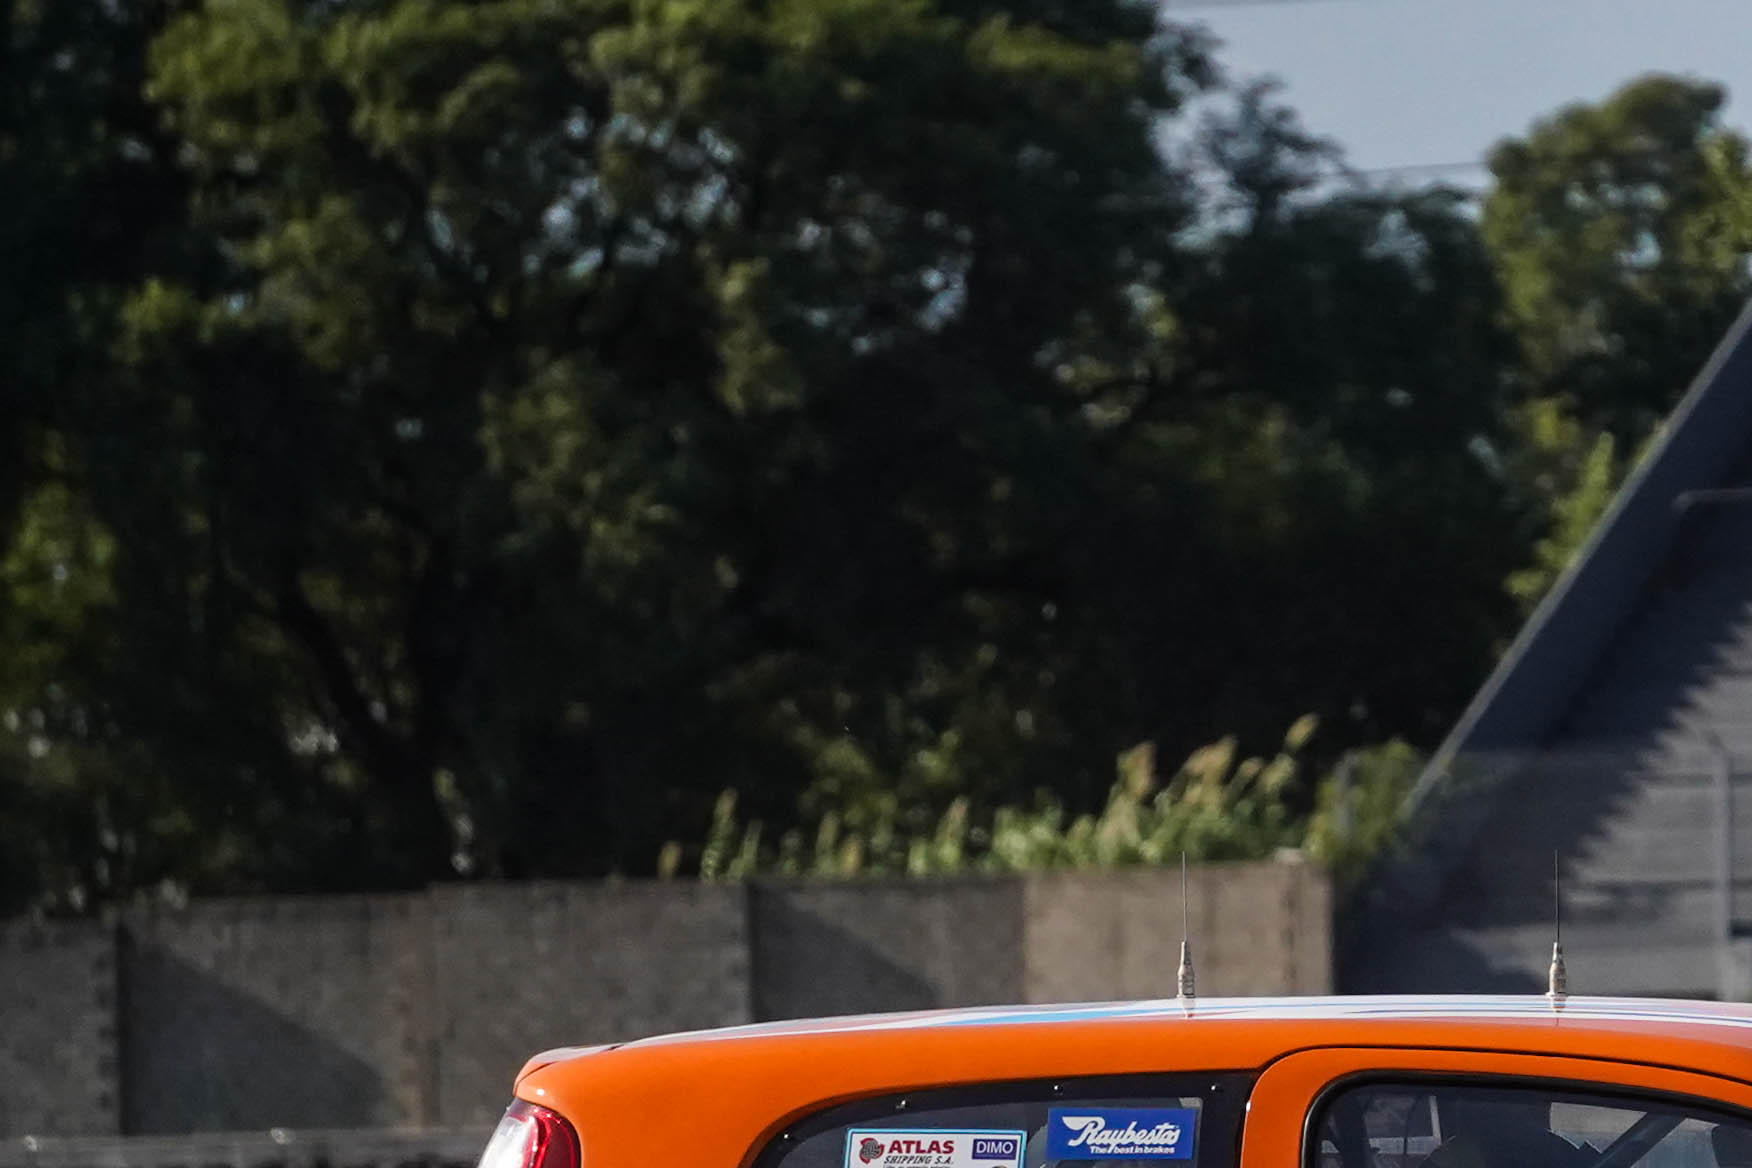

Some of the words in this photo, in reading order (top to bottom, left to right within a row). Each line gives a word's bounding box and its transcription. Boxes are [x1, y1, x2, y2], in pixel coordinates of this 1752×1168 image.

[888, 1140, 955, 1155] ATLAS
[975, 1140, 1015, 1155] DIMO
[1090, 1145, 1108, 1154] The
[1113, 1145, 1135, 1154] best
[1143, 1146, 1176, 1154] brakes
[883, 1155, 932, 1165] SHIPPING
[934, 1156, 954, 1165] S.A.
